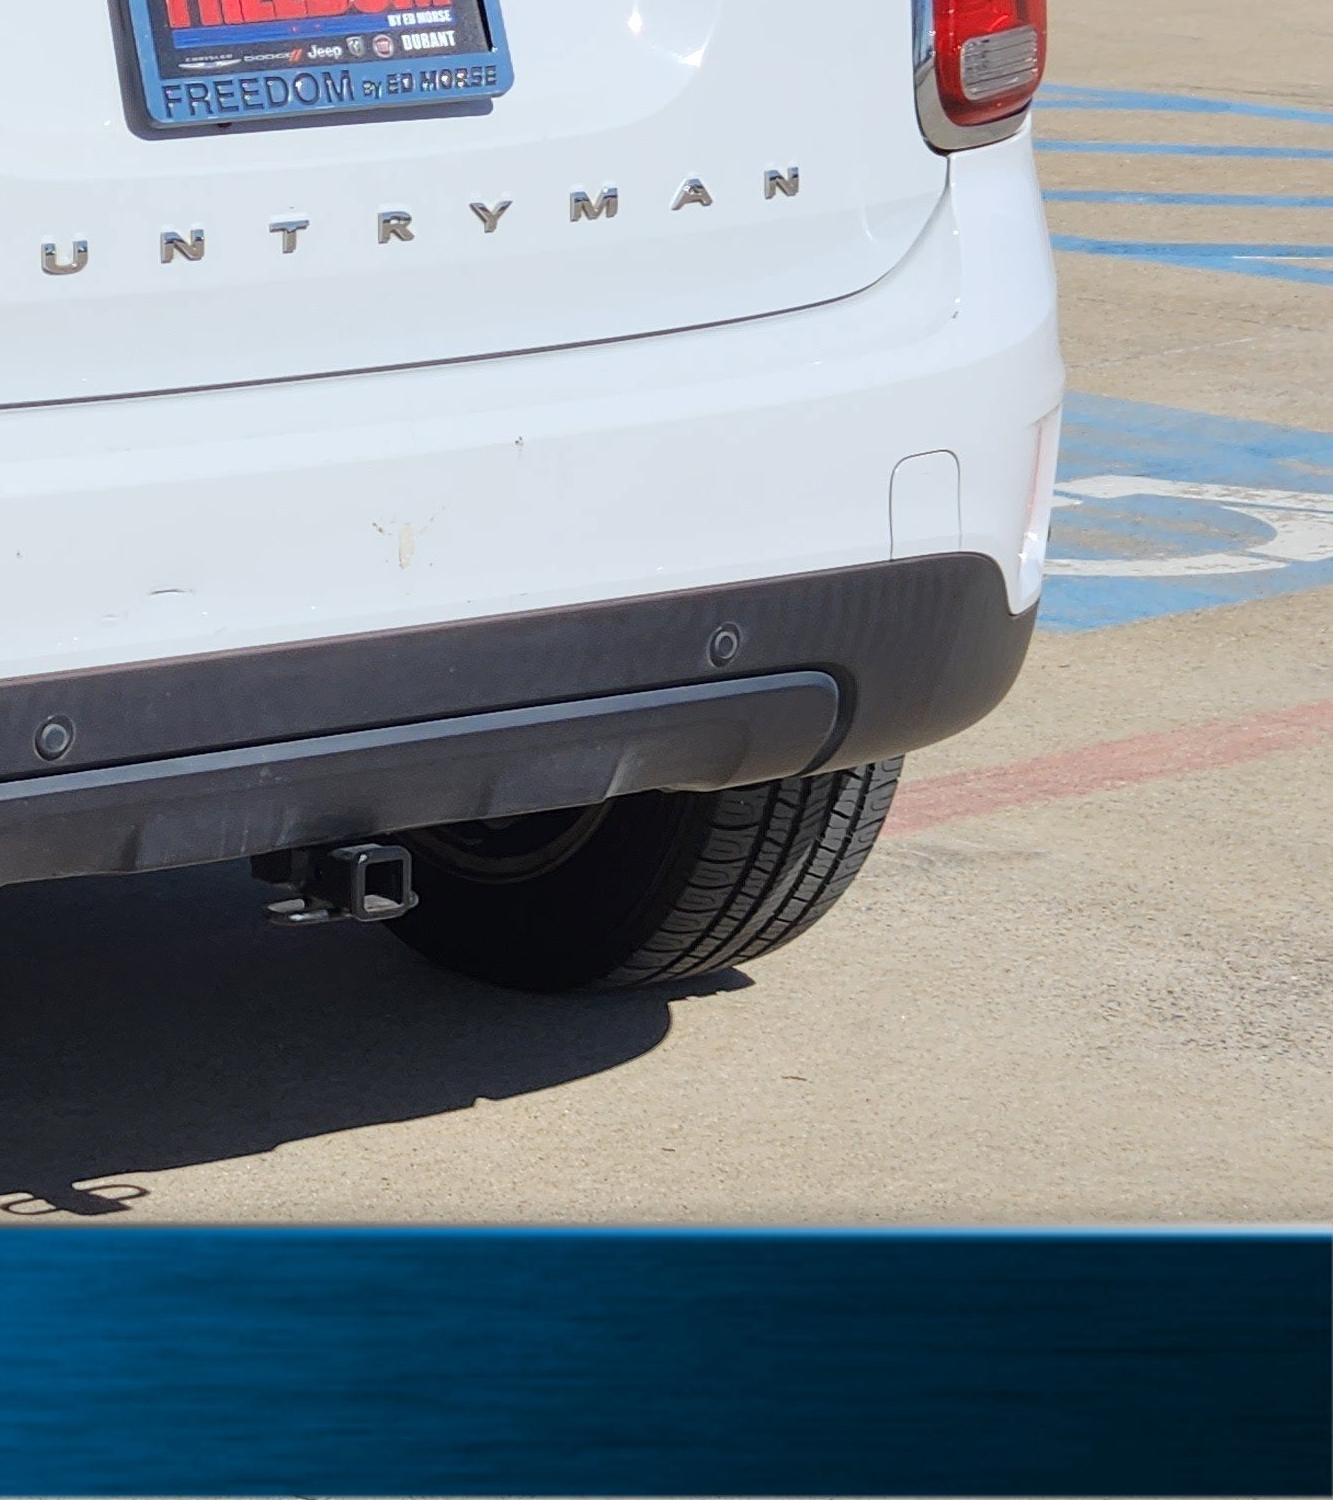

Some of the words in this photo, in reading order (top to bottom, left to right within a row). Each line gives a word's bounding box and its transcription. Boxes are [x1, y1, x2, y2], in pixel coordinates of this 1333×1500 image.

[387, 14, 402, 27] BY
[307, 45, 344, 59] Jeep
[401, 30, 457, 51] DURANT
[161, 69, 355, 118] FREEDOM
[362, 79, 382, 100] BY
[386, 69, 414, 95] ED
[418, 64, 498, 92] MORSE
